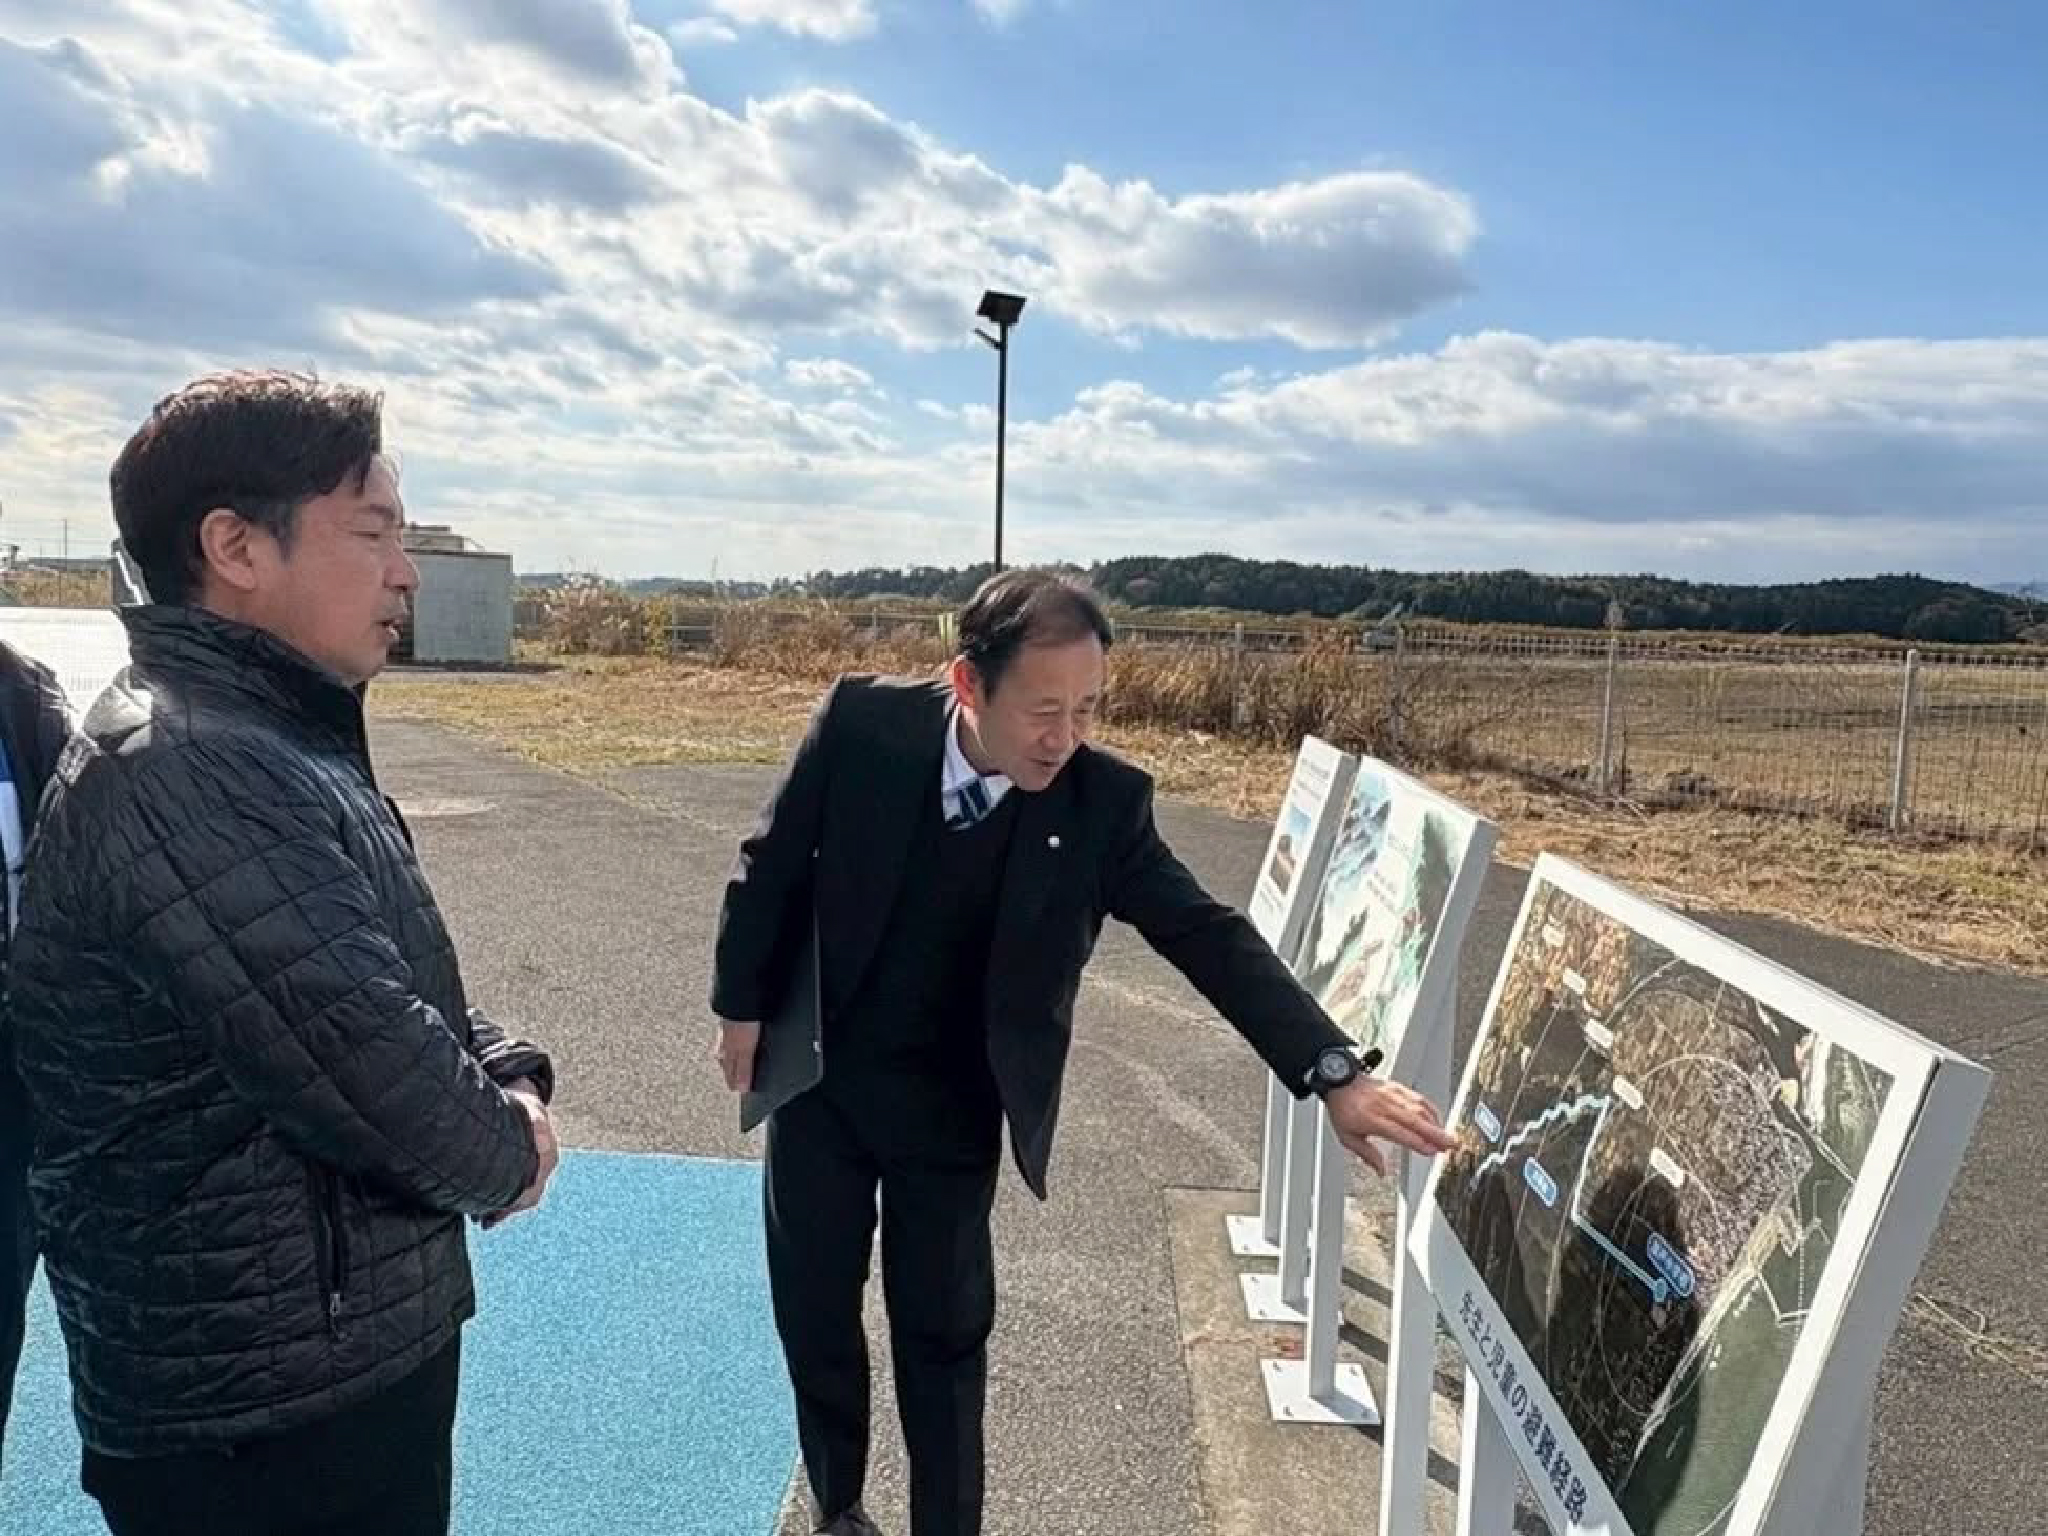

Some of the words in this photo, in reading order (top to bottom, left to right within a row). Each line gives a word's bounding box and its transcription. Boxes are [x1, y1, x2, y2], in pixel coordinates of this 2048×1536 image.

[1459, 1290, 1588, 1525] 先生と児童の避難経路
